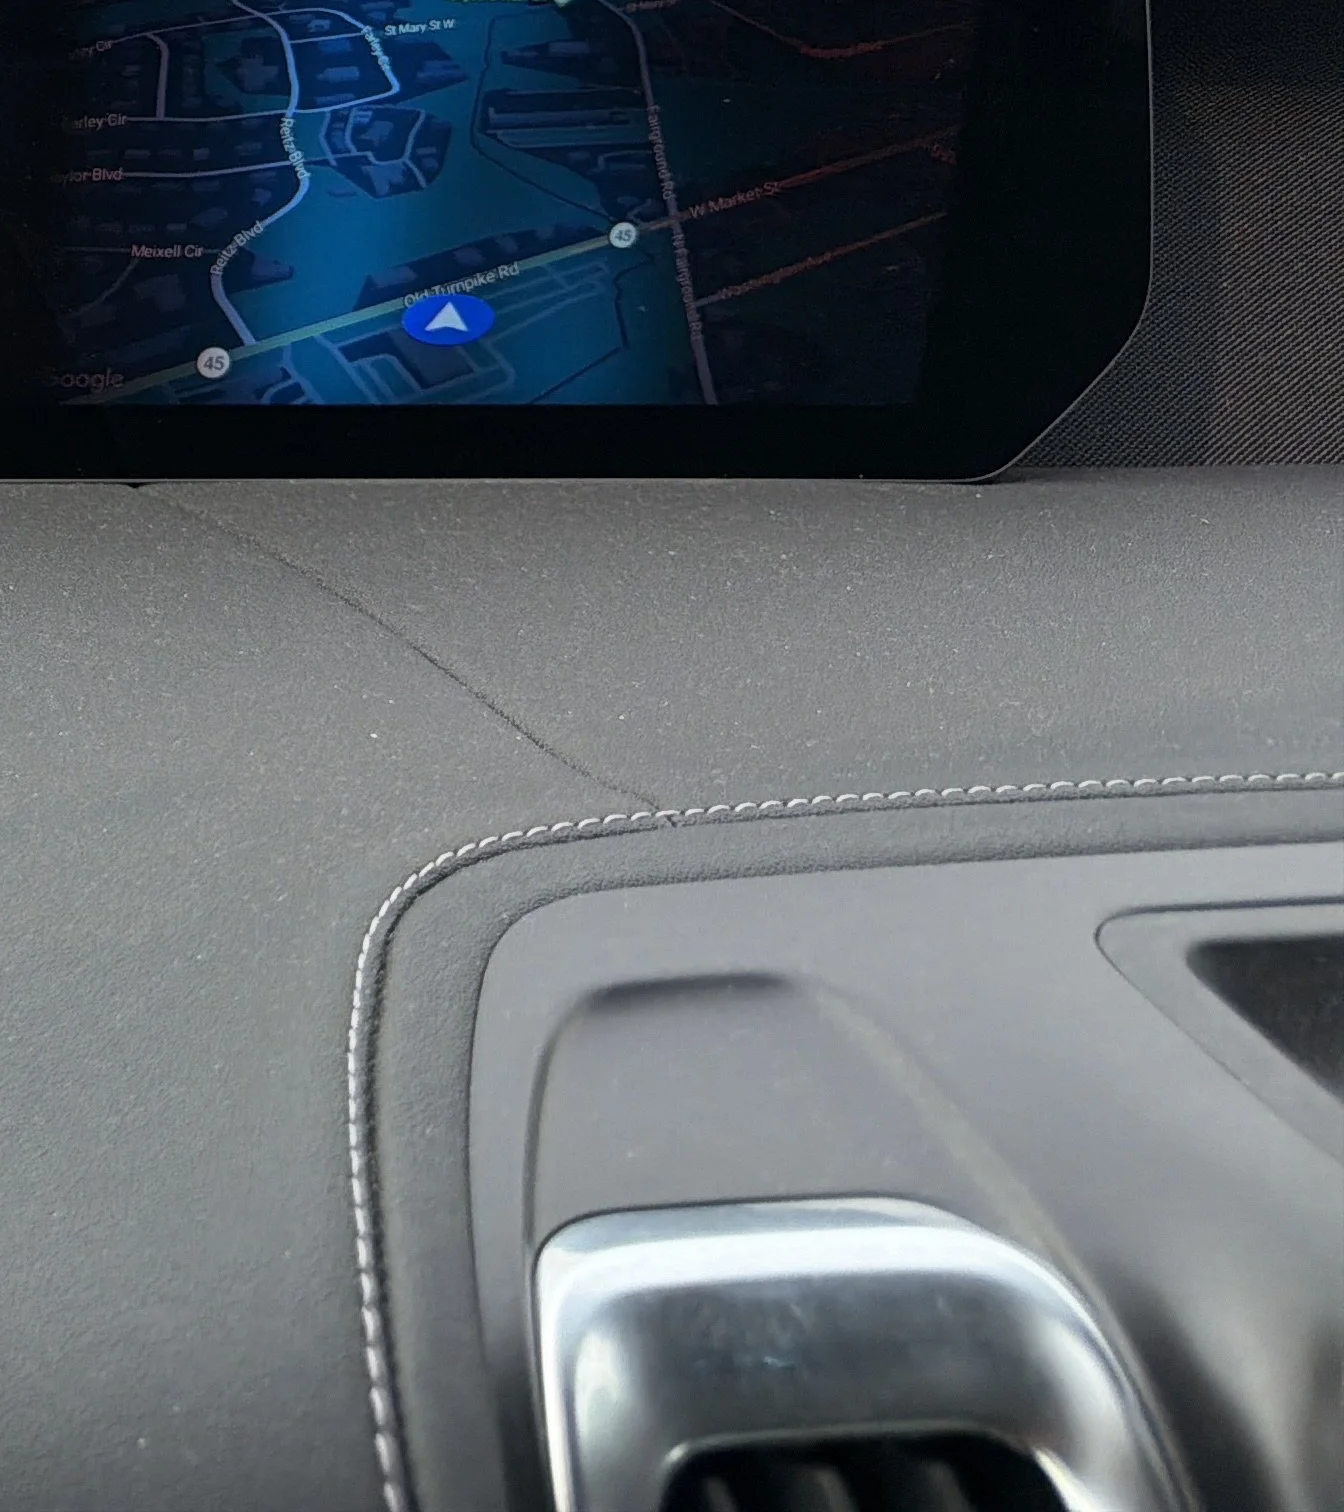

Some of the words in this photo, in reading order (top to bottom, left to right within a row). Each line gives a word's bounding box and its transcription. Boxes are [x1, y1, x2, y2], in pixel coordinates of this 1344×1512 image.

[398, 22, 427, 34] Mary
[442, 19, 456, 29] W
[288, 150, 311, 180] Blvd
[92, 167, 125, 182] Blvd
[708, 187, 761, 213] Market
[233, 219, 264, 247] Blvd
[130, 244, 180, 259] Meixell
[184, 244, 205, 259] Cir
[497, 261, 521, 280] Rd
[203, 355, 226, 371] 45
